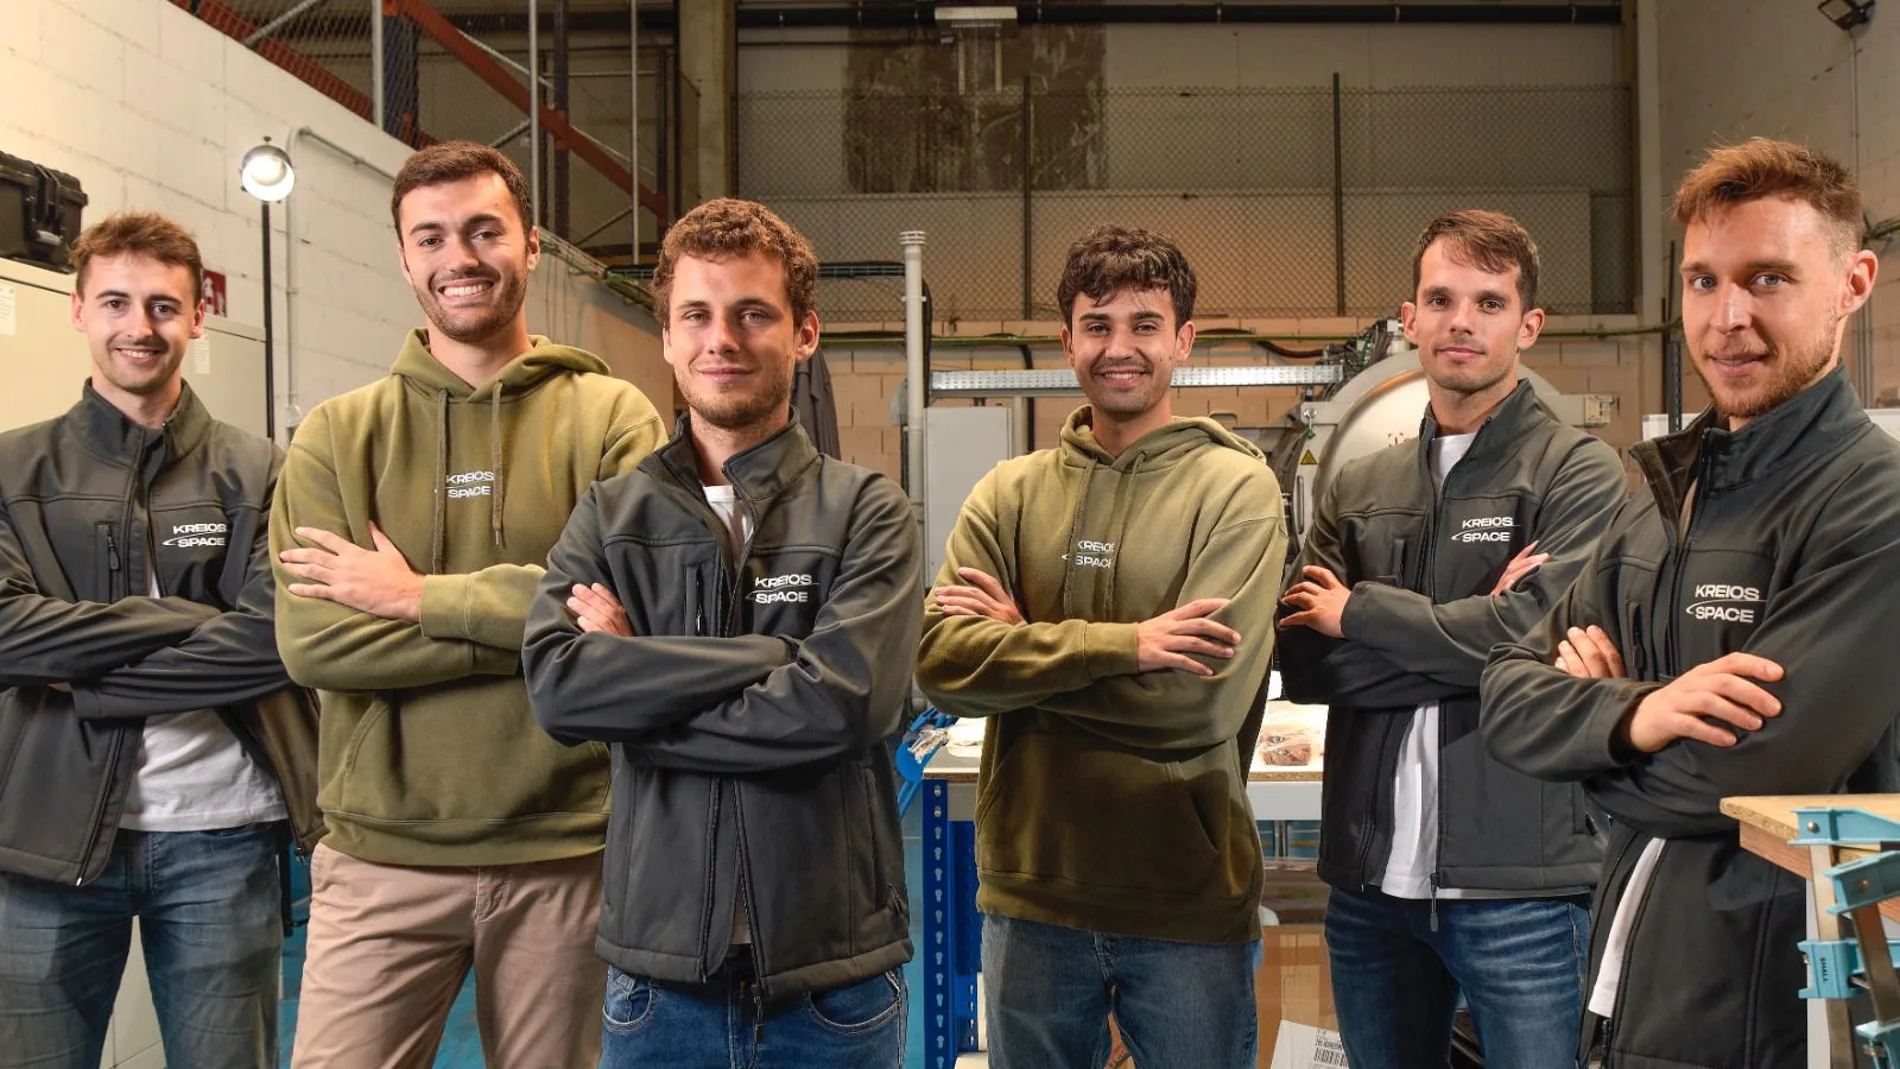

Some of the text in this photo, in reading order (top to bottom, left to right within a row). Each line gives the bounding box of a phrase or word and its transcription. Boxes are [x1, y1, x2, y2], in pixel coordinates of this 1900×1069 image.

[446, 471, 494, 484] KREIOS
[448, 486, 491, 498] SPACE
[1462, 517, 1514, 528] KREIOS
[173, 524, 226, 534] KREIOS
[178, 538, 226, 548] SPACE
[1462, 532, 1510, 542] SPACE
[755, 574, 812, 588] KREIOS
[756, 592, 808, 604] SPACE
[1695, 584, 1760, 600] KREIOS
[1696, 607, 1754, 623] SPACE
